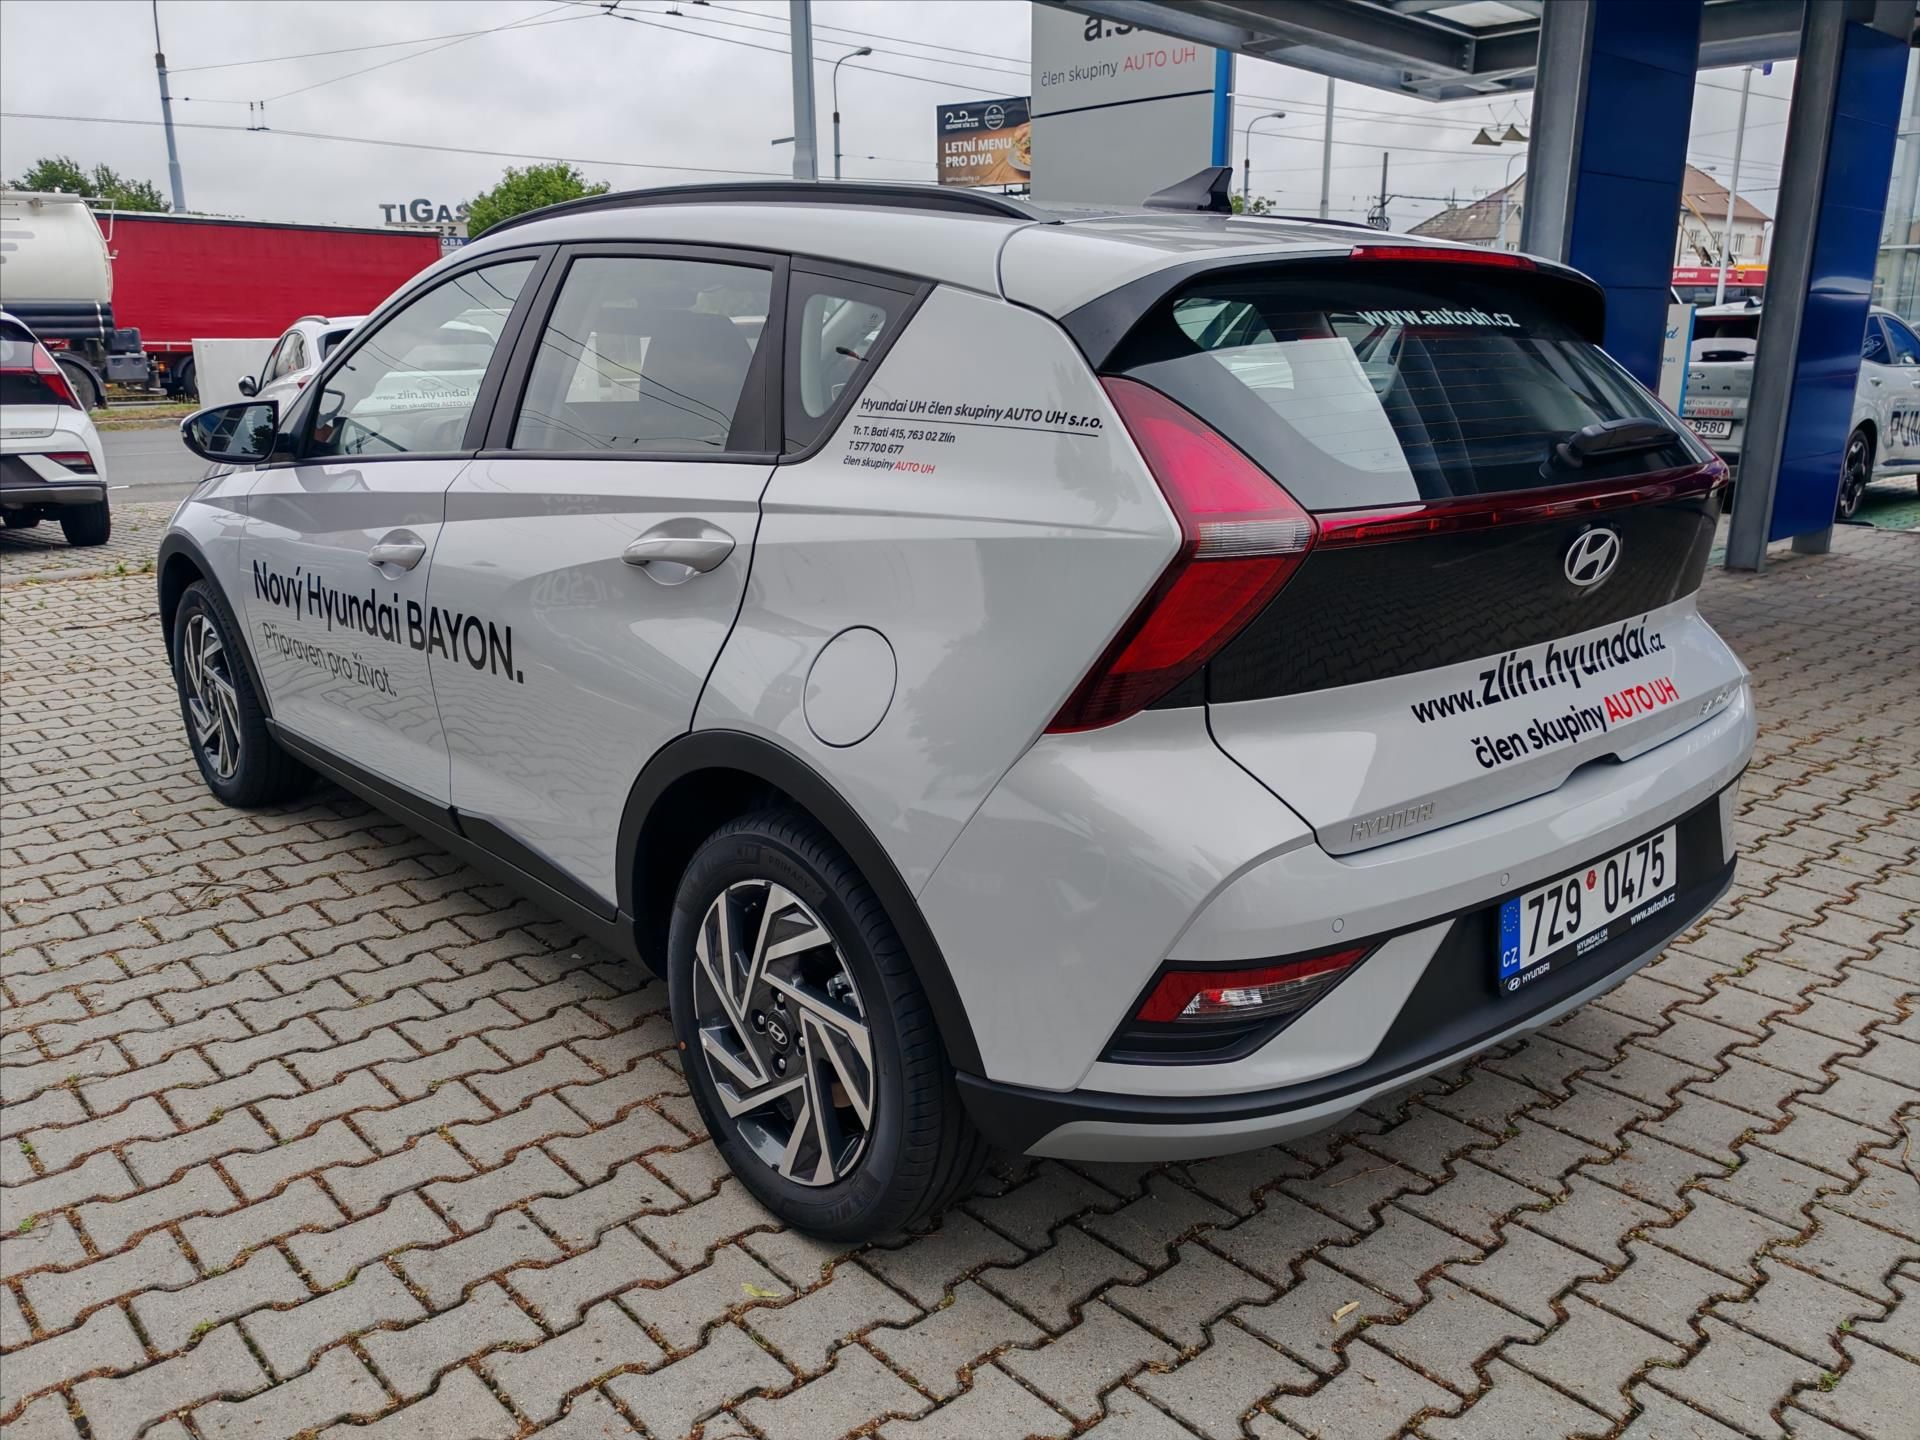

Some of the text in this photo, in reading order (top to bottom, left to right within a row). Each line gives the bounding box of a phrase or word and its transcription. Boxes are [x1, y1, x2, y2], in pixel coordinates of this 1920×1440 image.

[1041, 46, 1196, 87] člen skupiny AUTO UH
[945, 137, 1012, 154] LETNÍ MENU
[945, 153, 993, 168] PRO DVA
[1356, 307, 1521, 328] www.autouh.cz
[860, 398, 1103, 429] Hyundai UH člen skupiny AUTO UH s.r.o.
[871, 427, 889, 437] Bati
[889, 428, 906, 440] 415,
[907, 430, 924, 440] 763
[925, 431, 938, 441] 02
[1695, 420, 1725, 434] 9580
[854, 441, 869, 451] 577
[870, 443, 886, 453] 700
[887, 444, 904, 455] 677
[843, 455, 936, 474] člen skupiny AUTO UH
[253, 559, 524, 684] Nový Hyundai BAYON.
[262, 622, 398, 697] Připraven pro život.
[1470, 731, 1528, 768] člen
[1528, 705, 1607, 751] skupiny
[1604, 682, 1653, 723] AUTO
[1652, 676, 1680, 706] UH
[1528, 834, 1665, 957] 7Z9 0475
[1630, 893, 1676, 926] www.autouh.cz
[1503, 947, 1518, 968] CZ
[1522, 962, 1550, 984] HYUNDAI
